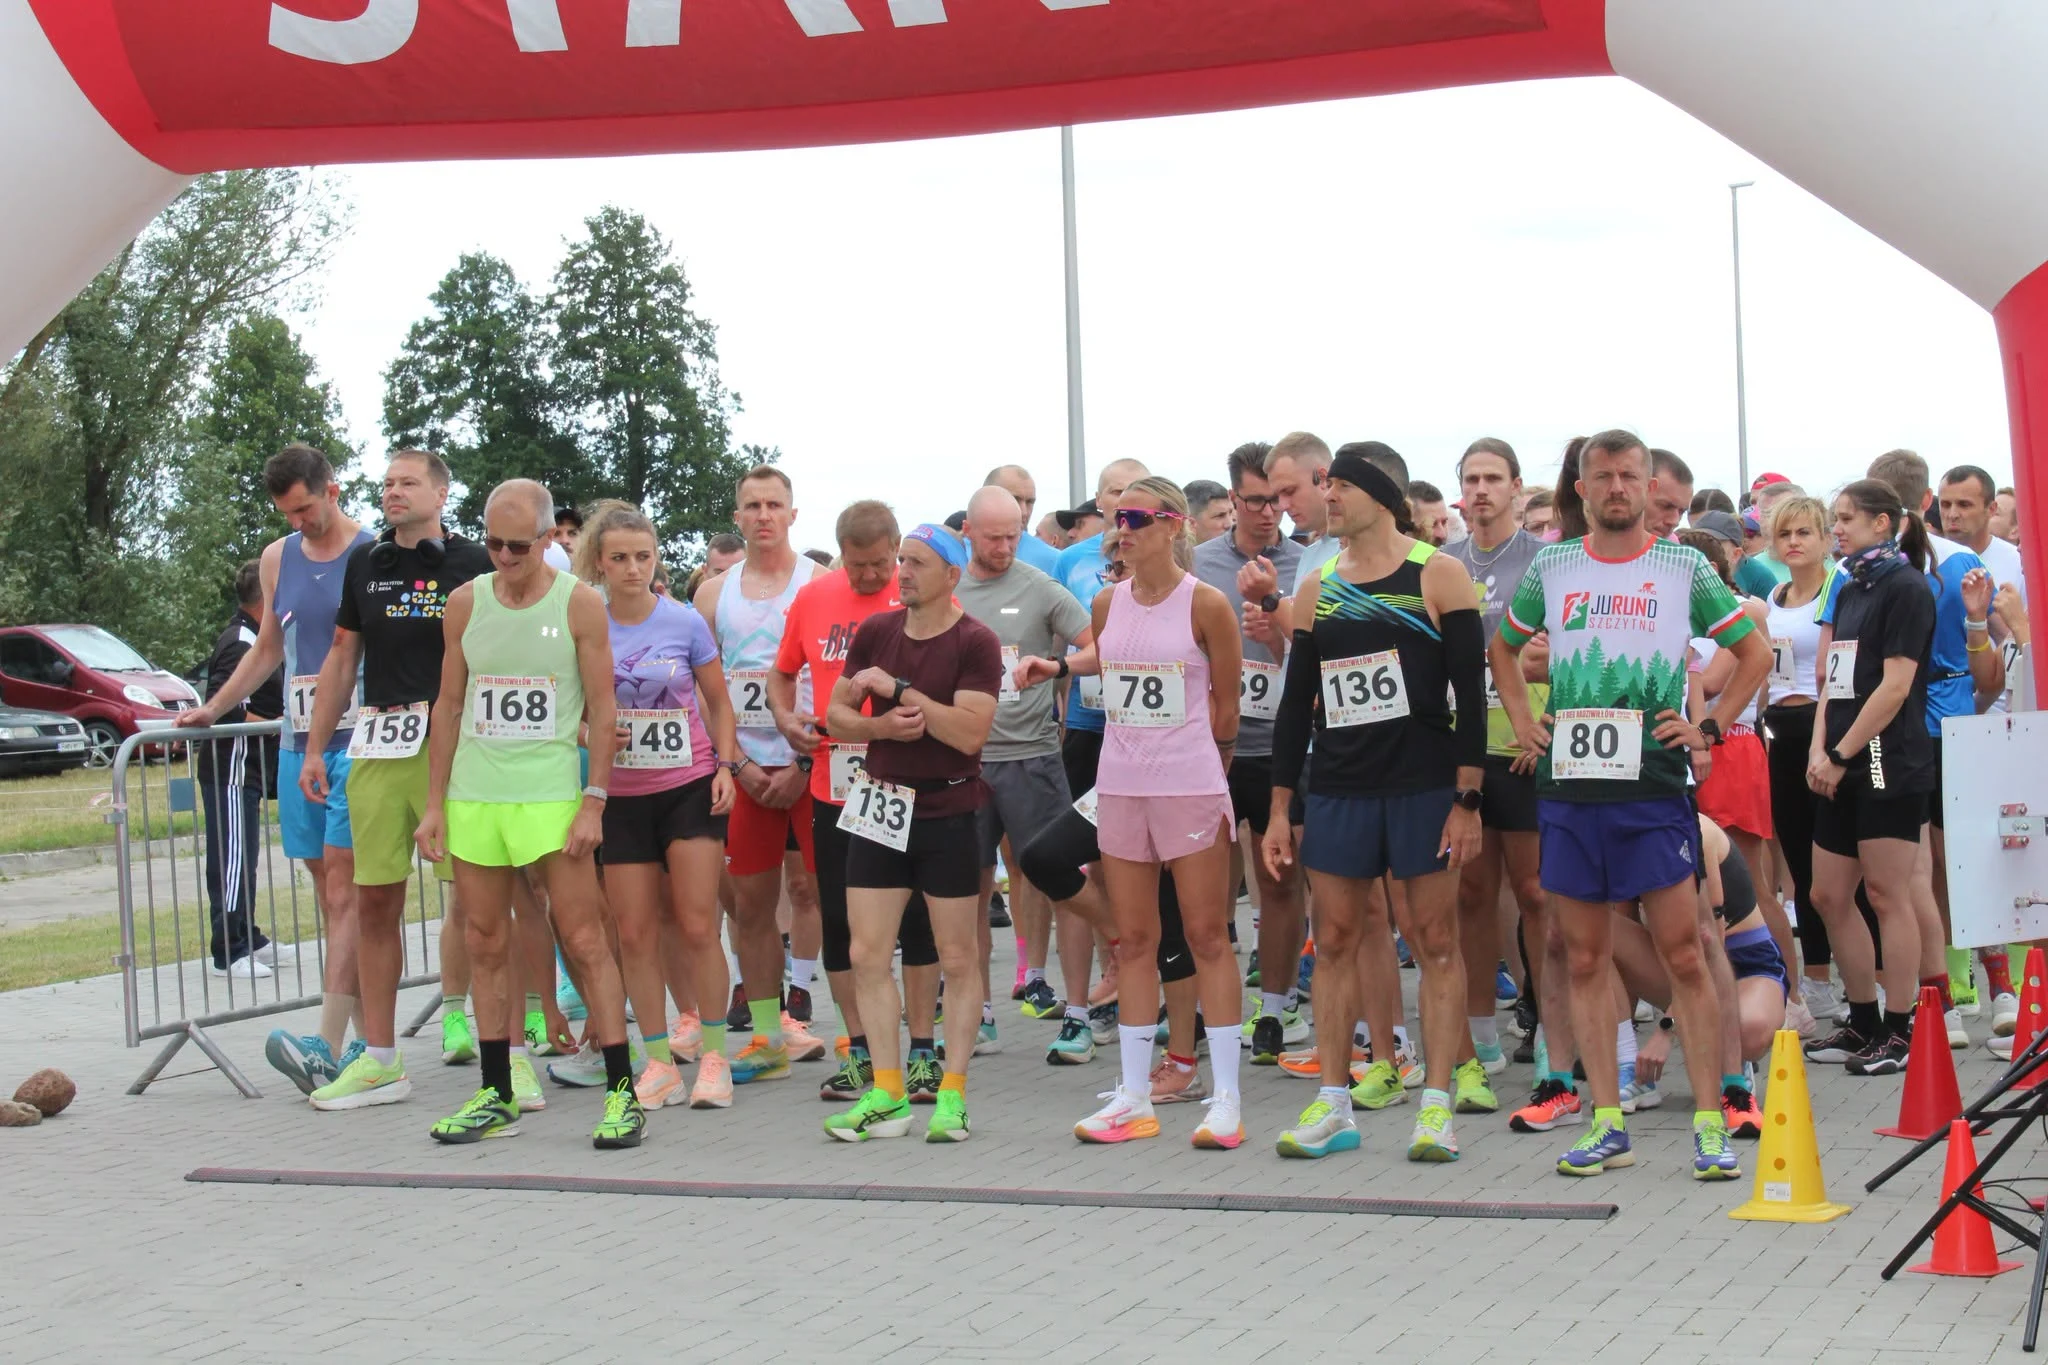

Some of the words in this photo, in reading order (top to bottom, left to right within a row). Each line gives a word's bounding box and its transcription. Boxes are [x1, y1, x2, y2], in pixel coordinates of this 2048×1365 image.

[1591, 595, 1657, 618] JURUND
[1589, 617, 1656, 632] SZCZYTNO
[1119, 675, 1164, 710] 78
[1329, 665, 1398, 708] 136
[481, 689, 548, 723] 168
[363, 714, 421, 745] 158
[1569, 722, 1619, 760] 80
[858, 787, 907, 831] 133
